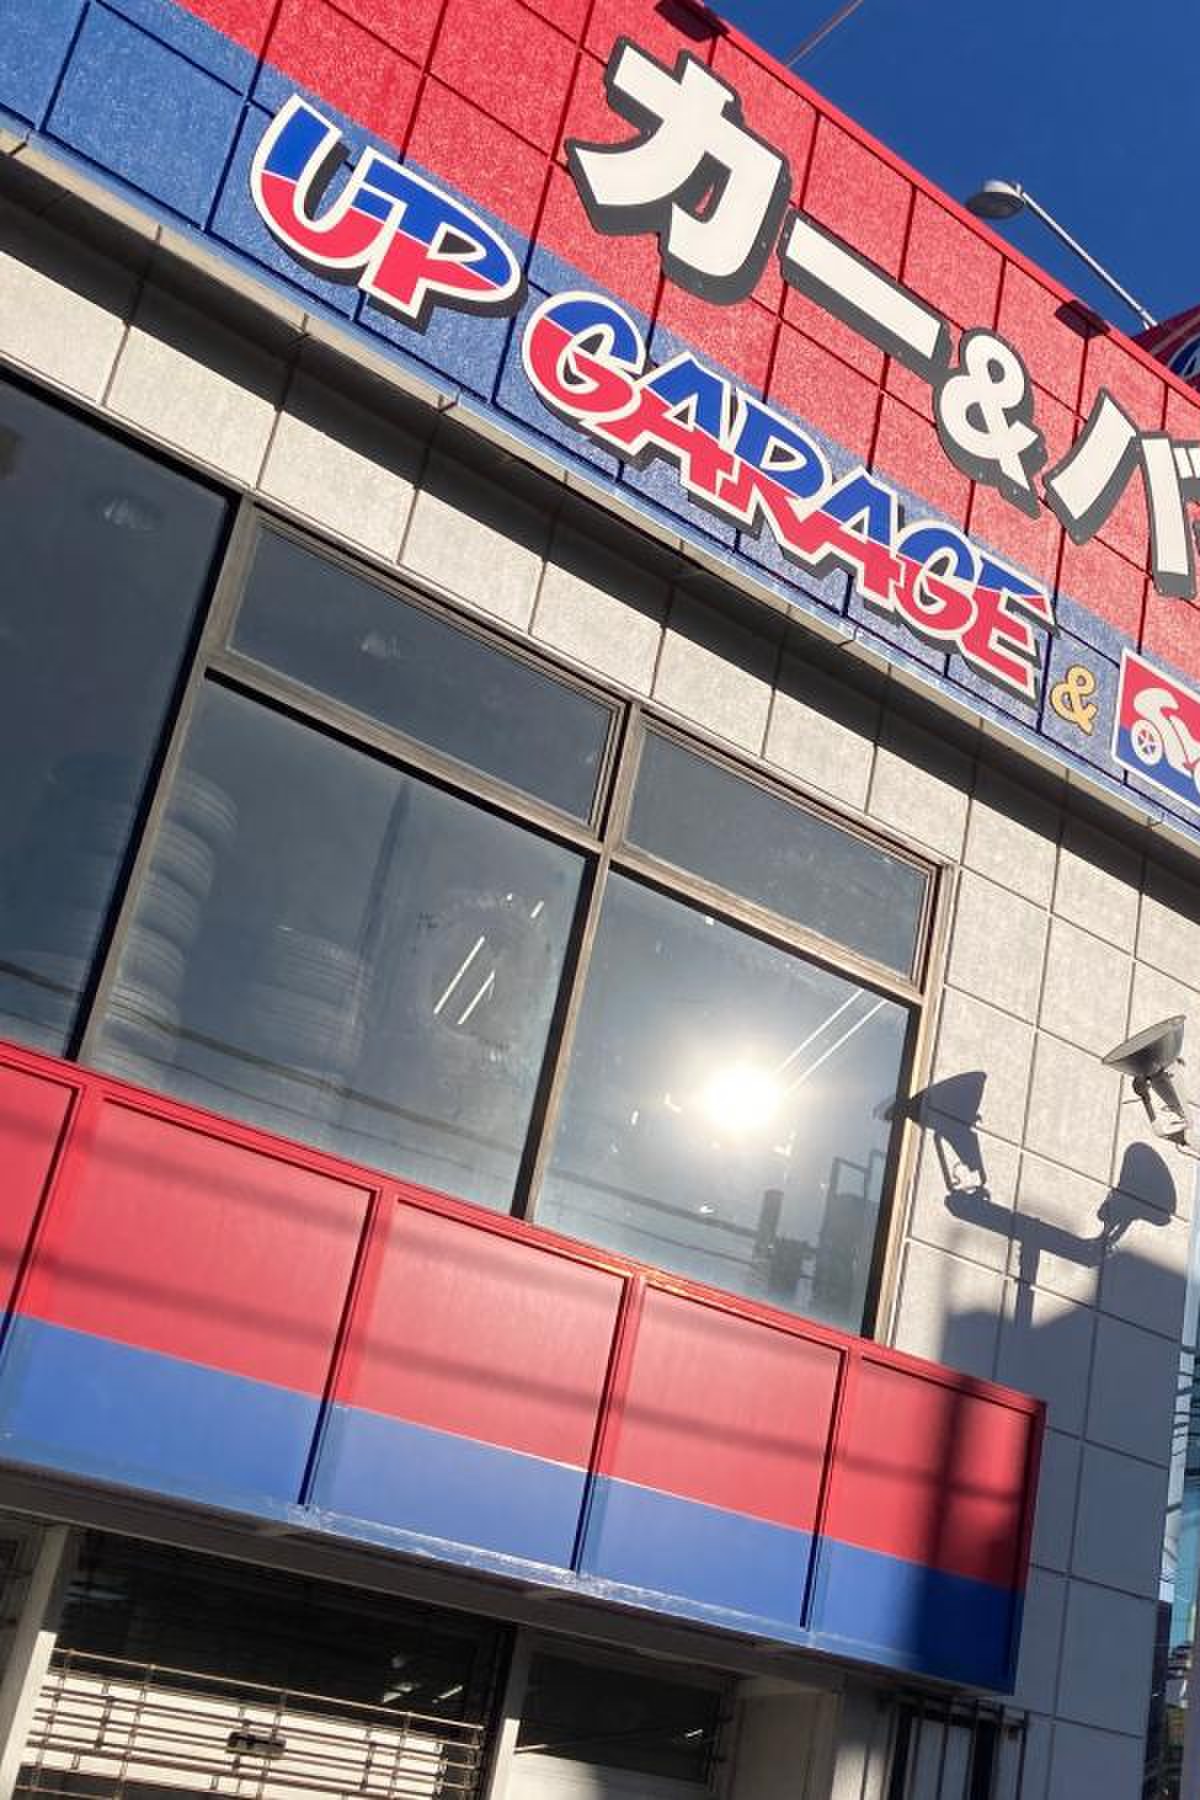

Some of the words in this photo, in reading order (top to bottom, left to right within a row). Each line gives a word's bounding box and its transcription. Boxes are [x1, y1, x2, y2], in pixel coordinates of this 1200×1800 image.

[249, 94, 524, 326] UP
[522, 290, 1057, 702] GARAGE
[1050, 664, 1099, 736] &
